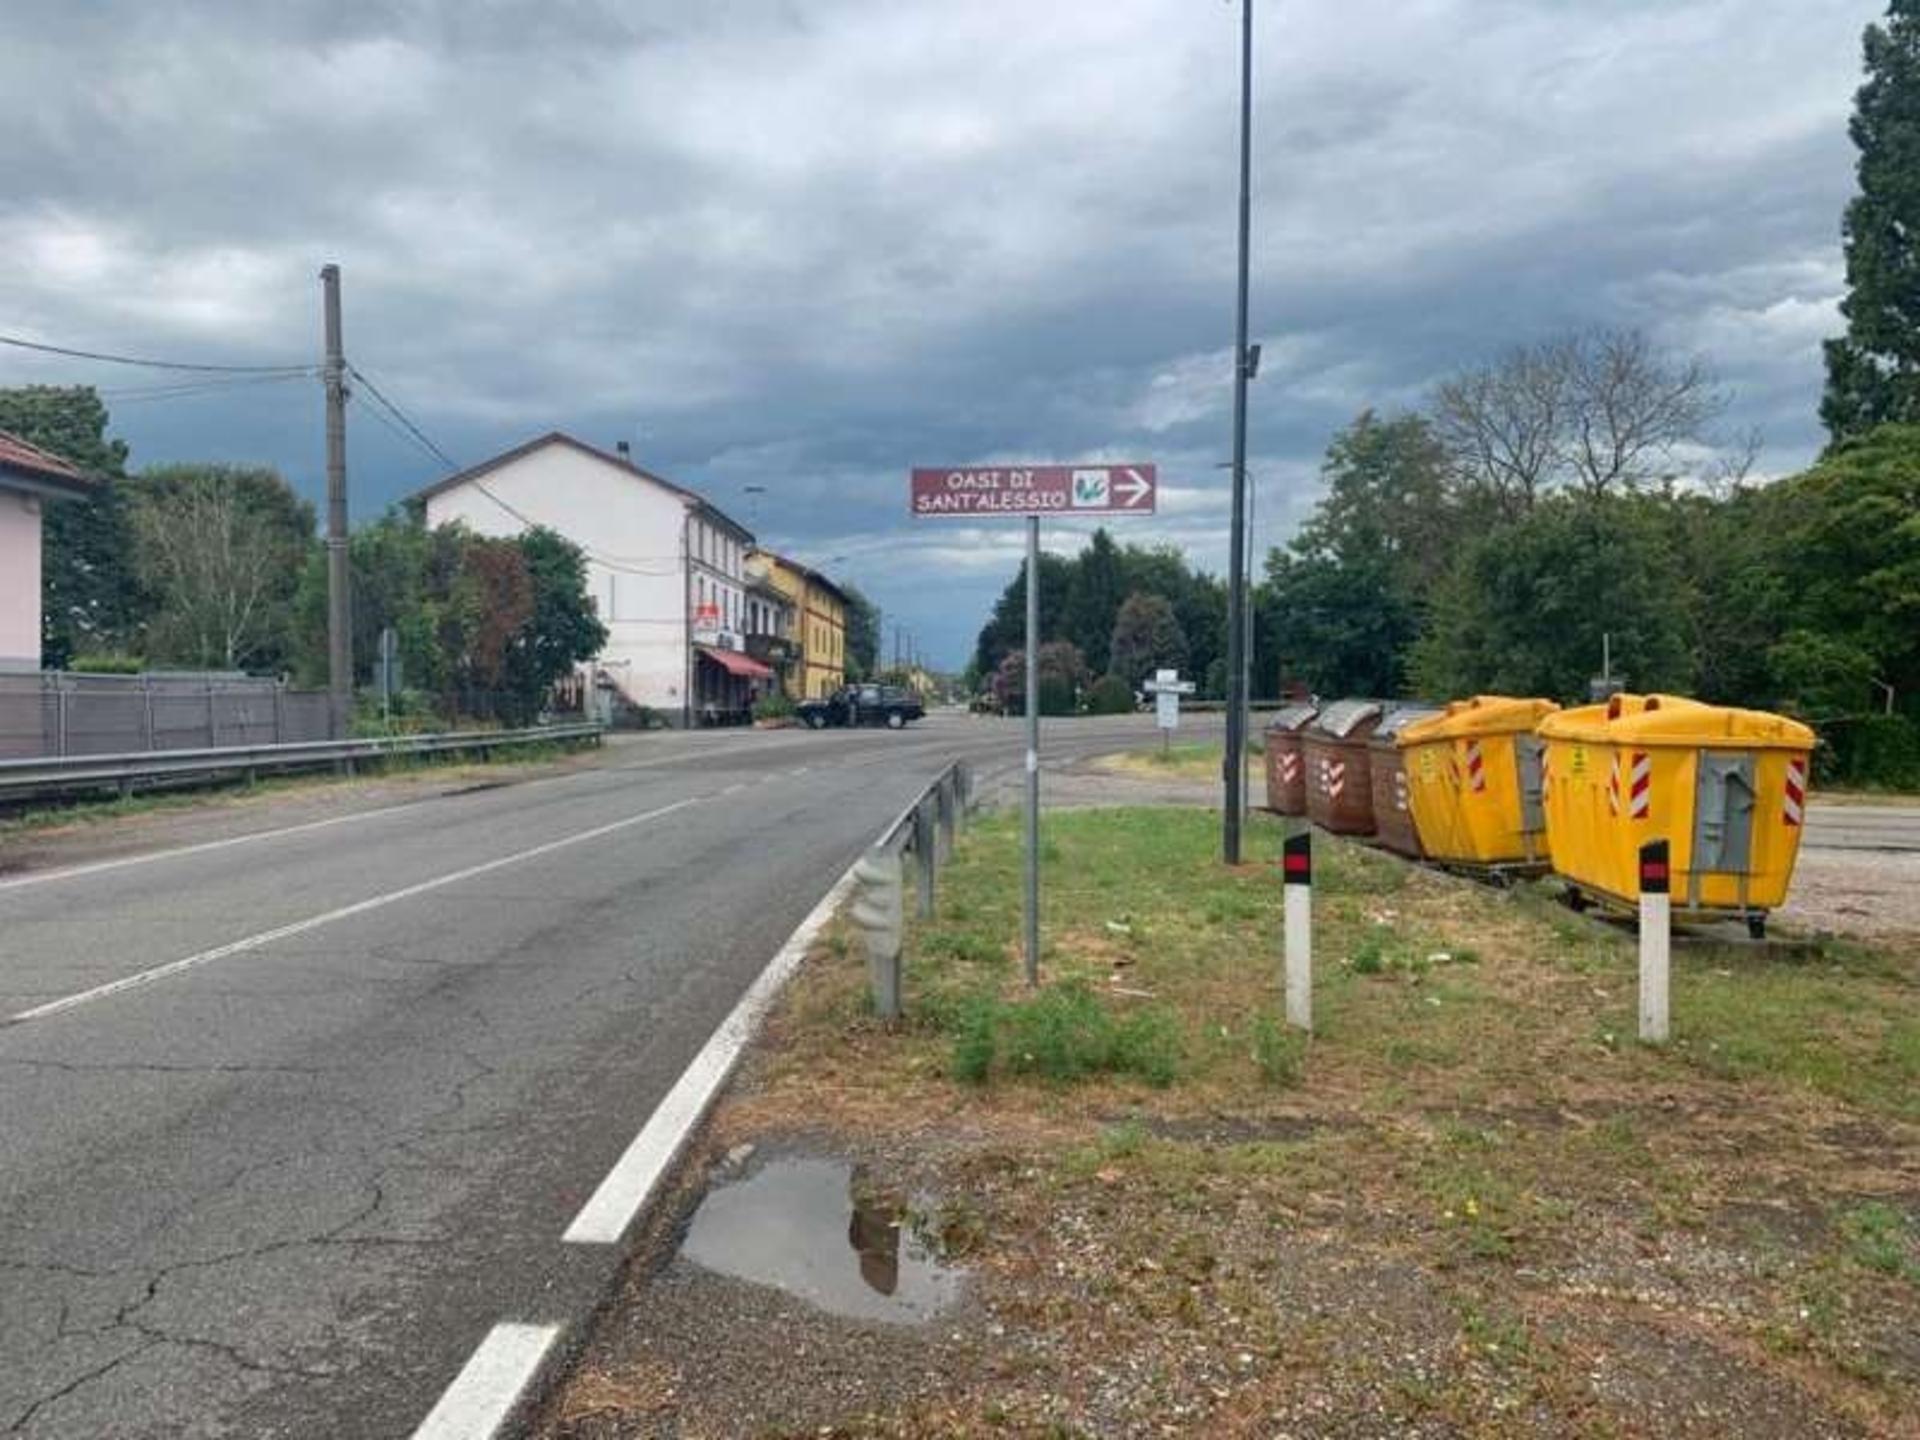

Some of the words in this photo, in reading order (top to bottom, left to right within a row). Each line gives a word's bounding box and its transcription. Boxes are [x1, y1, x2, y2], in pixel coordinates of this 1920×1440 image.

[948, 472, 999, 489] OASI
[1009, 471, 1034, 488] DI
[917, 491, 1066, 510] SANT'ALESSIO
